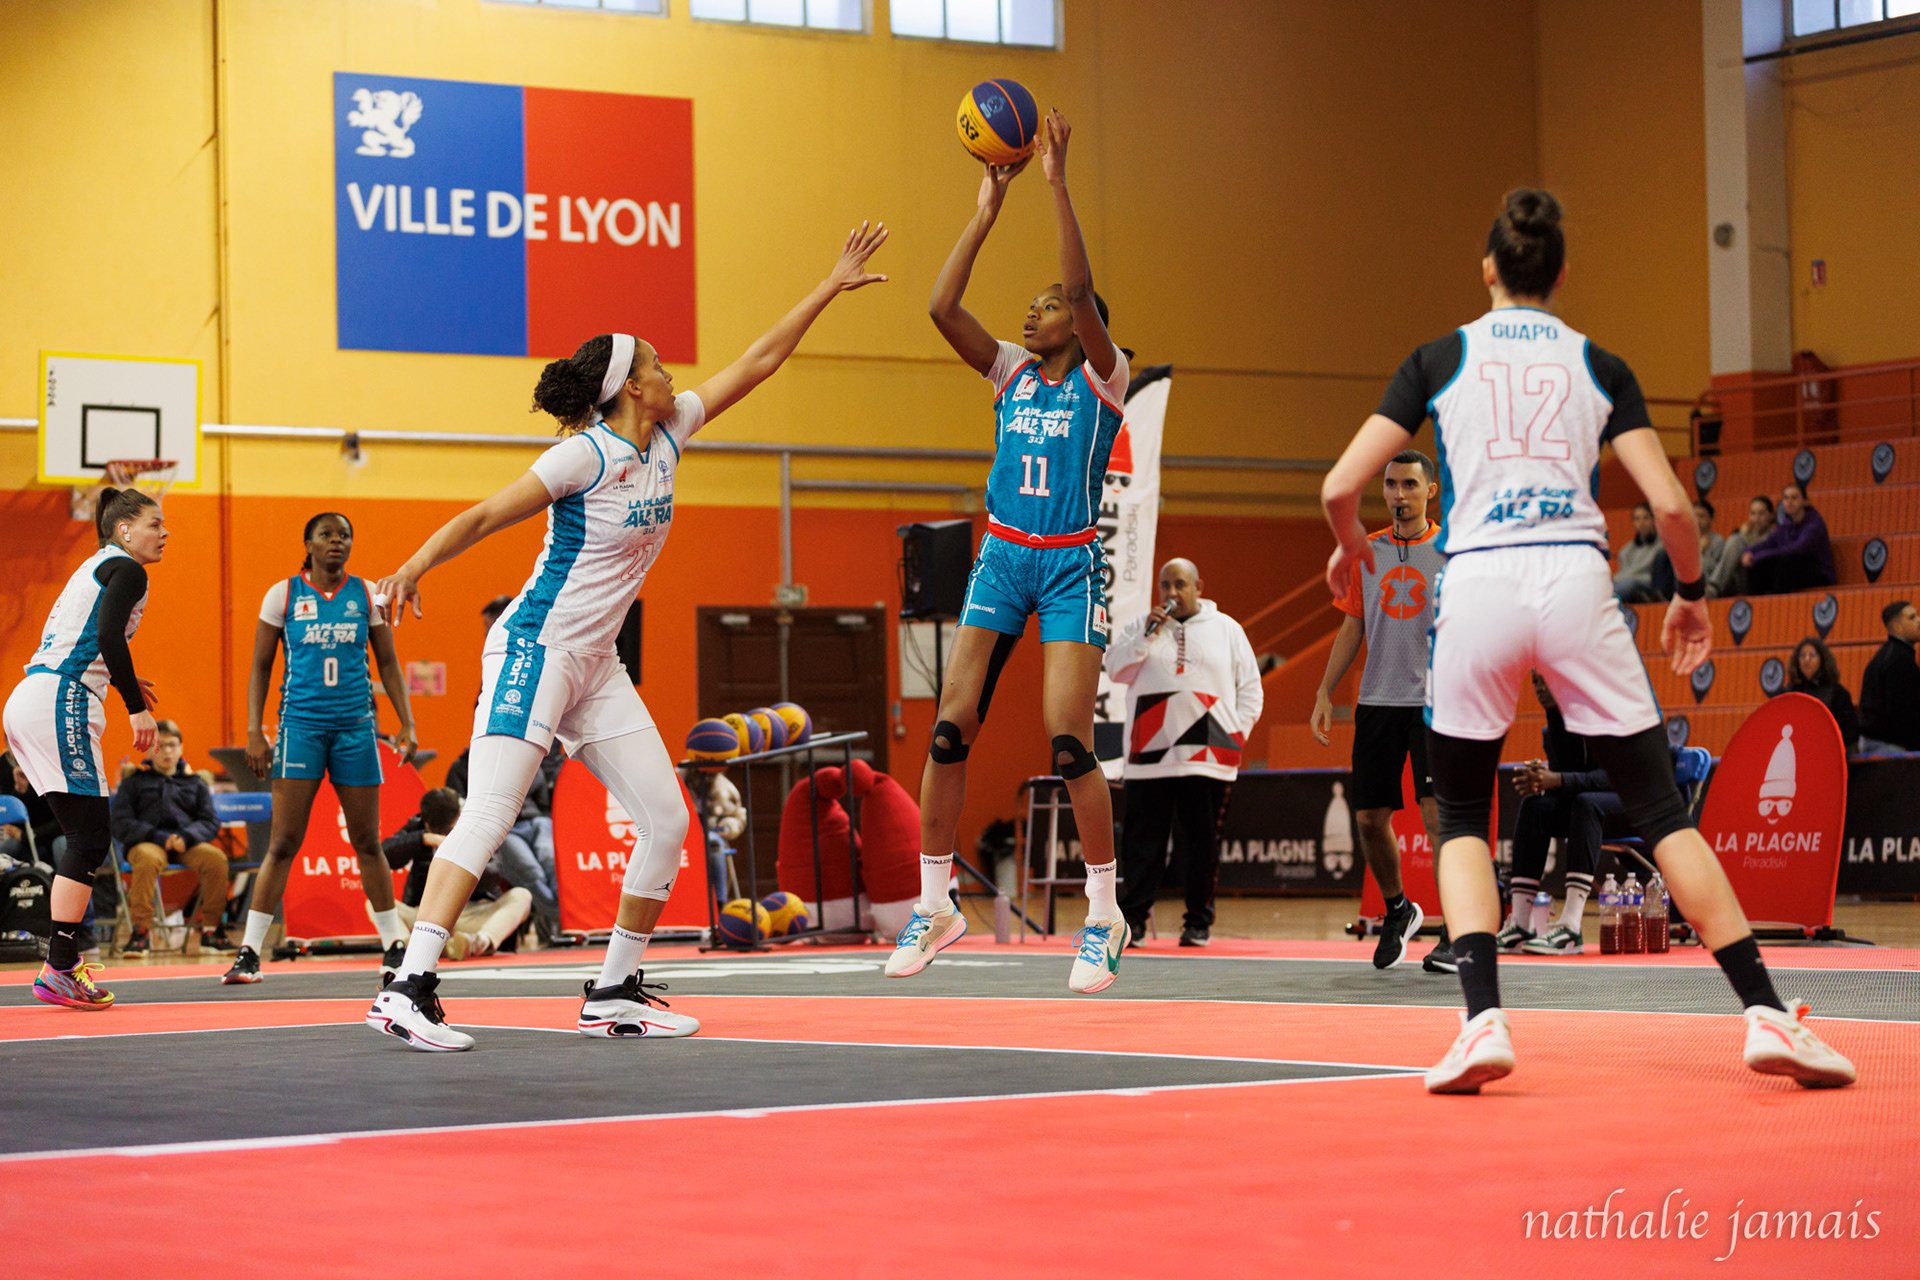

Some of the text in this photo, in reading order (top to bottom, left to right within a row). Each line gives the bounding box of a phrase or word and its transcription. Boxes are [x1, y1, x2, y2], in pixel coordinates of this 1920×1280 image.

[346, 182, 681, 248] VILLE DE LYON
[1492, 322, 1558, 341] GUAPO
[1014, 406, 1075, 420] LA PLAGNE
[1479, 361, 1571, 460] 12
[1019, 454, 1050, 497] 11
[628, 500, 641, 509] LA
[1123, 503, 1140, 582] Paradiski
[969, 603, 996, 614] SPALDING
[306, 624, 319, 632] LA
[324, 656, 338, 687] 0
[518, 672, 528, 686] DE
[66, 681, 77, 755] LIGUE AURA
[1220, 840, 1316, 862] LA PLAGNE
[1715, 832, 1822, 852] LA PLAGNE
[1848, 838, 1874, 862] LA
[303, 857, 332, 875] LA
[577, 852, 603, 871] LA
[1743, 856, 1788, 868] Paradiski
